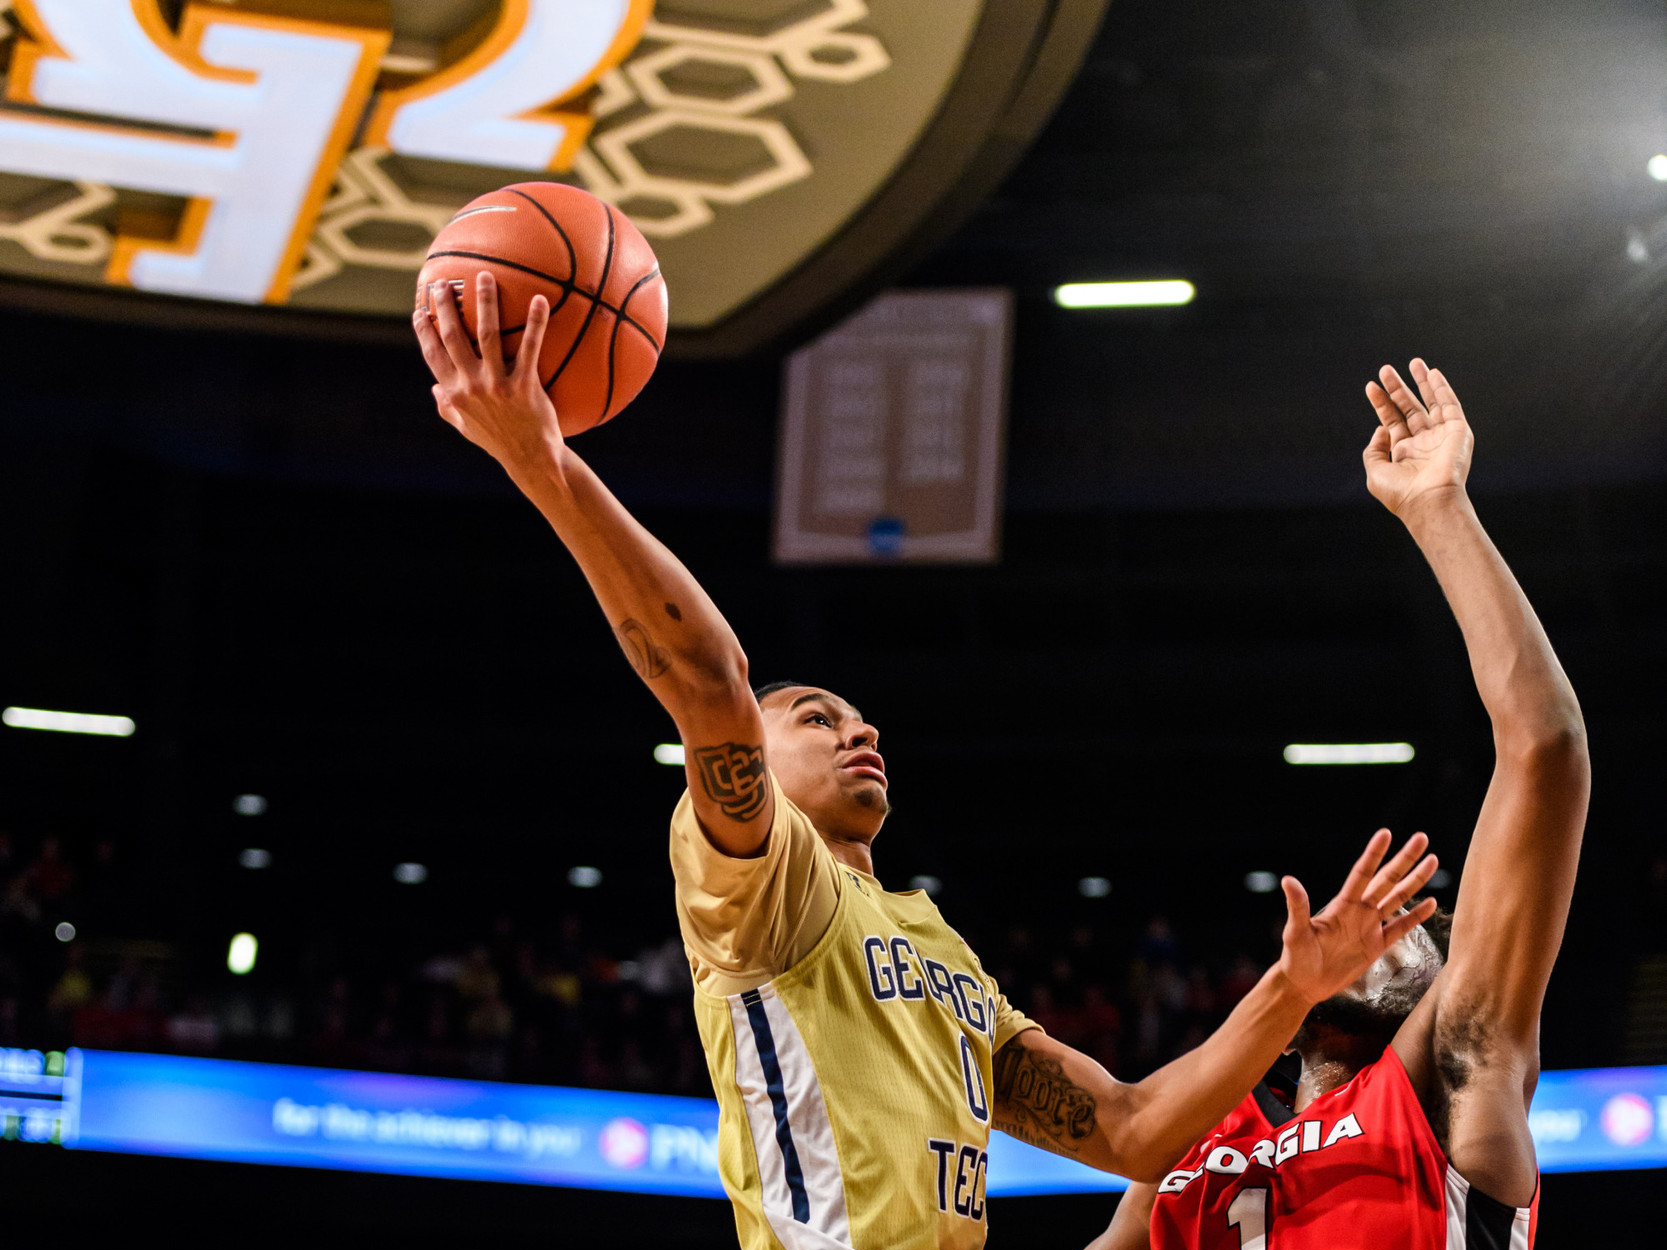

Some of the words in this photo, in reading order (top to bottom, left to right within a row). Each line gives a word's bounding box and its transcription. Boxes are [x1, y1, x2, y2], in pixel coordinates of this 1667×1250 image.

[863, 935, 996, 1046] GERGA
[959, 1031, 989, 1125] 0
[928, 1138, 988, 1222] TEC
